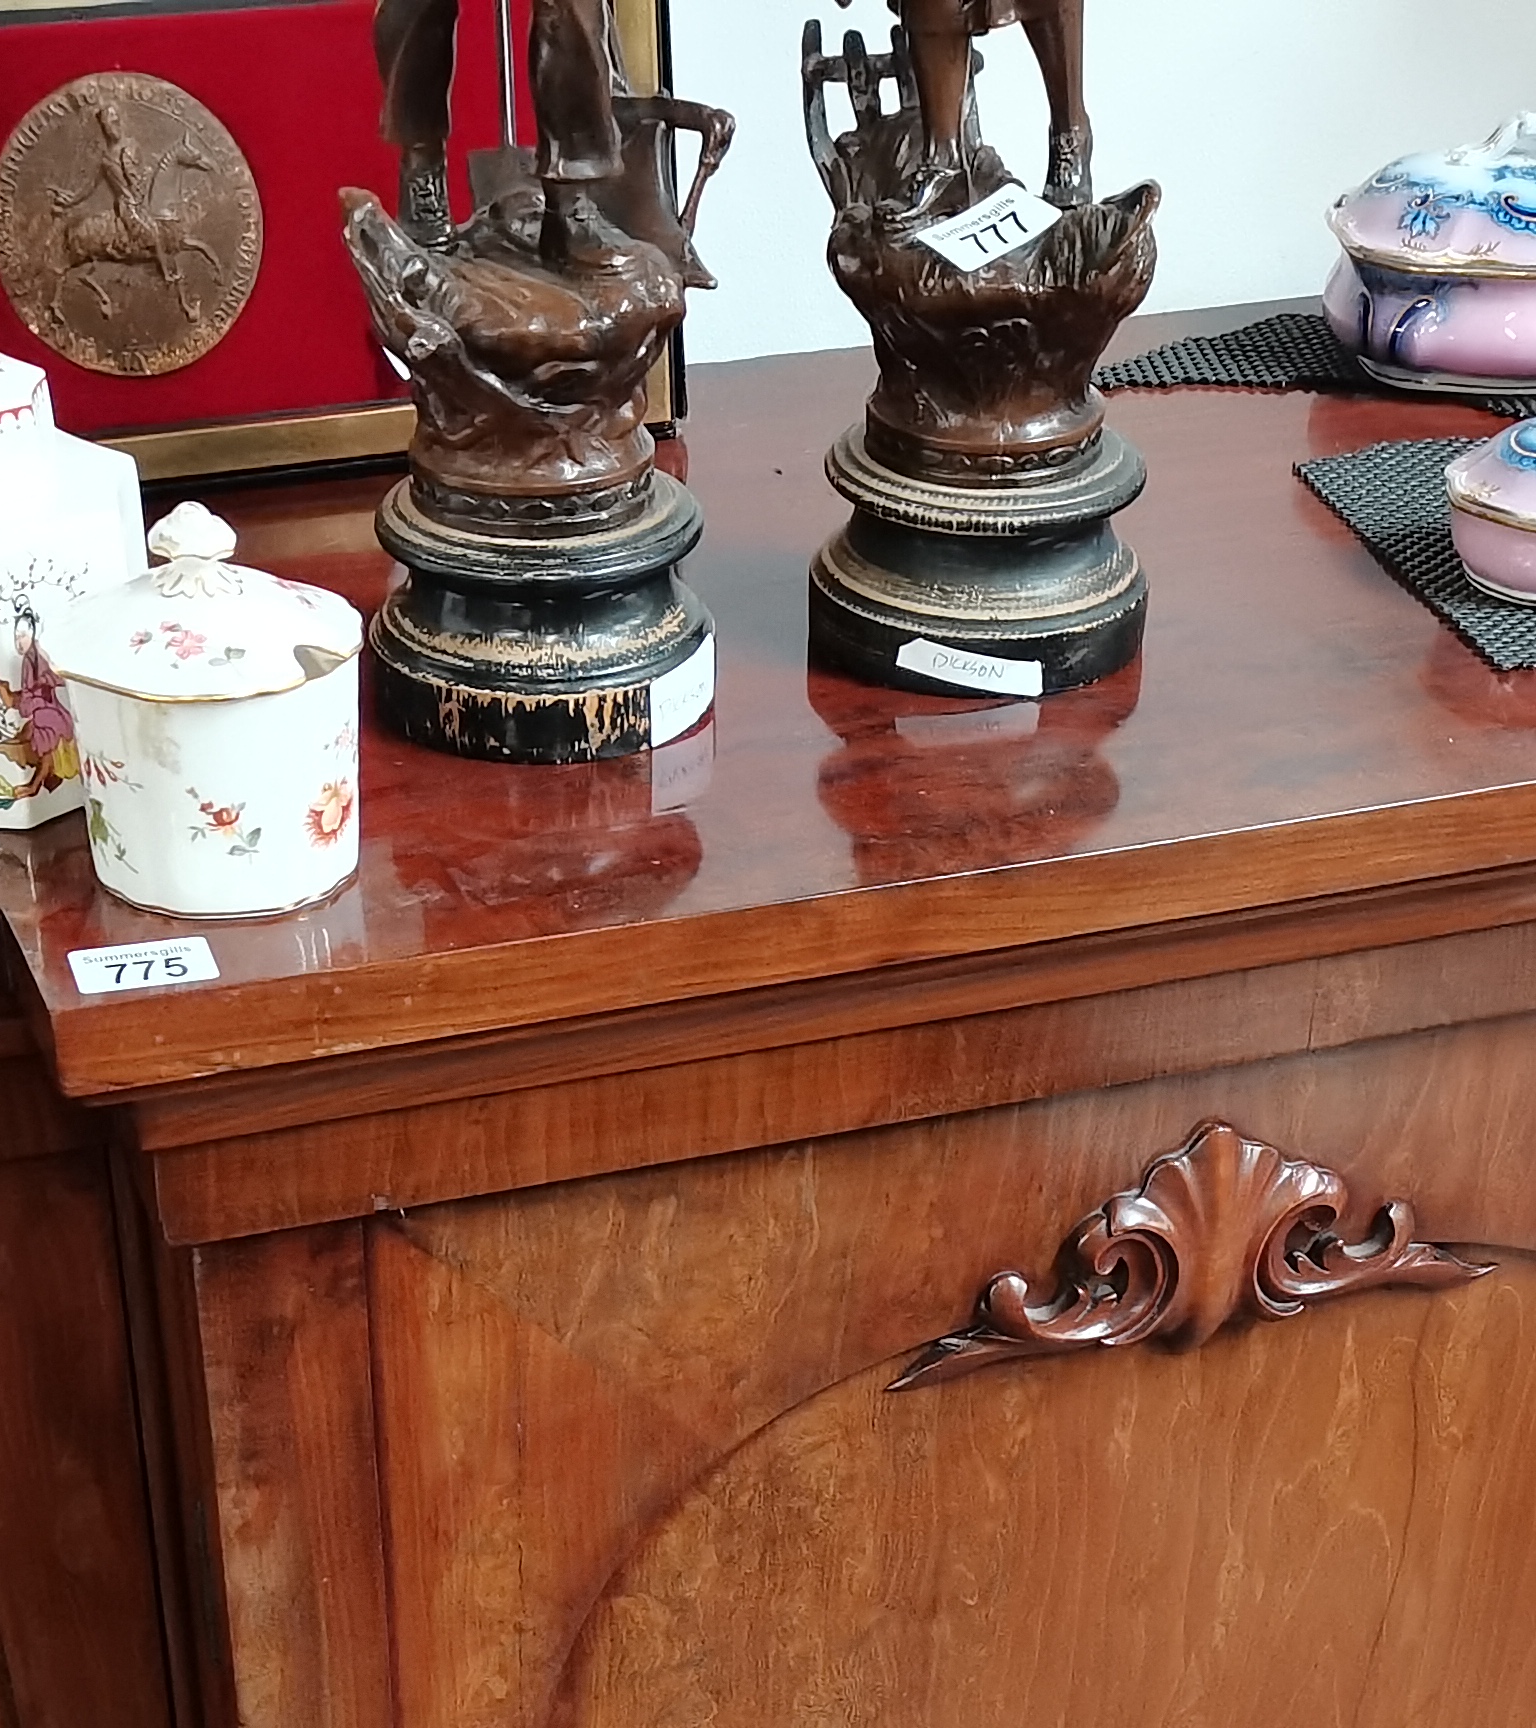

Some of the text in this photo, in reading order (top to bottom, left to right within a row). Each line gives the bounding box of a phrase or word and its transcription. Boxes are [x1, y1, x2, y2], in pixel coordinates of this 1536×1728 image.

[931, 196, 1015, 242] Summersgills
[958, 210, 1029, 254] 777
[932, 652, 1005, 679] DICKSON
[82, 945, 192, 965] Summersgills
[104, 956, 189, 984] 775
